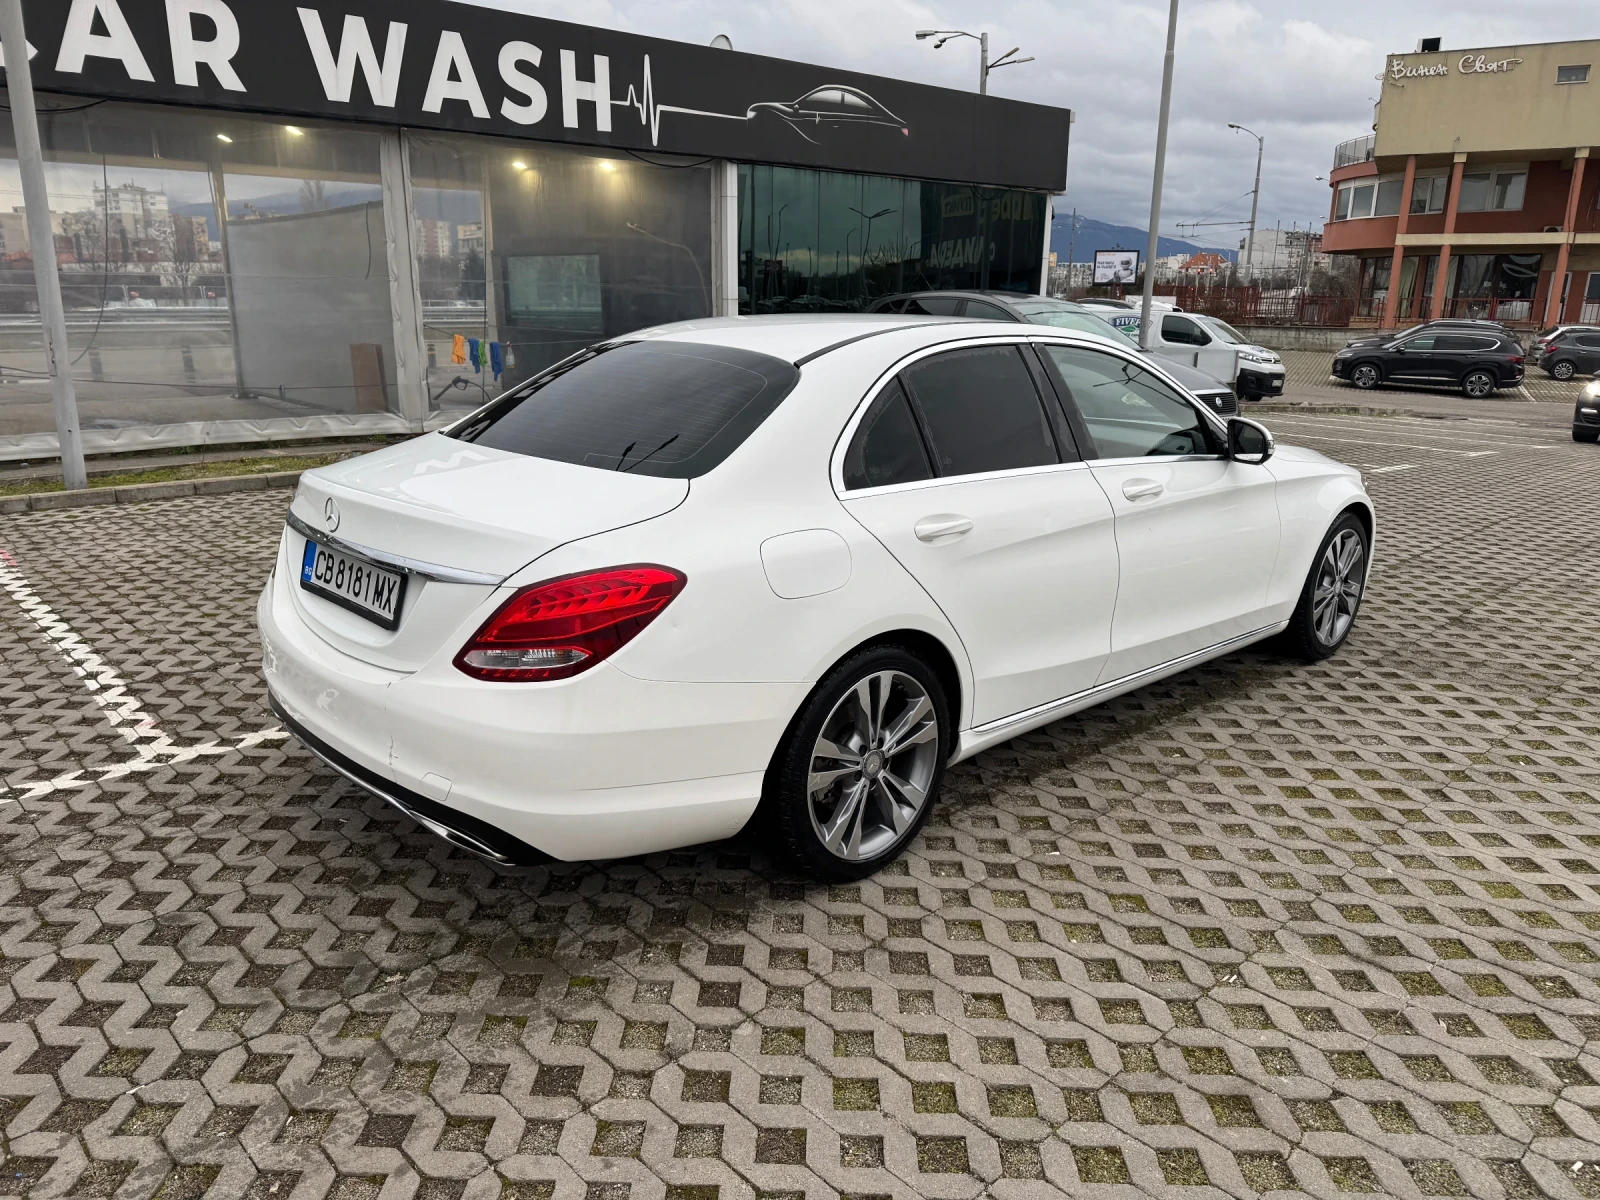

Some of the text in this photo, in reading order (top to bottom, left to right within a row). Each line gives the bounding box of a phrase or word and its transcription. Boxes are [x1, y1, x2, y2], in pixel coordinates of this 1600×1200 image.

[0, 0, 611, 132] AR WASH
[1391, 55, 1522, 79] Винен Свят
